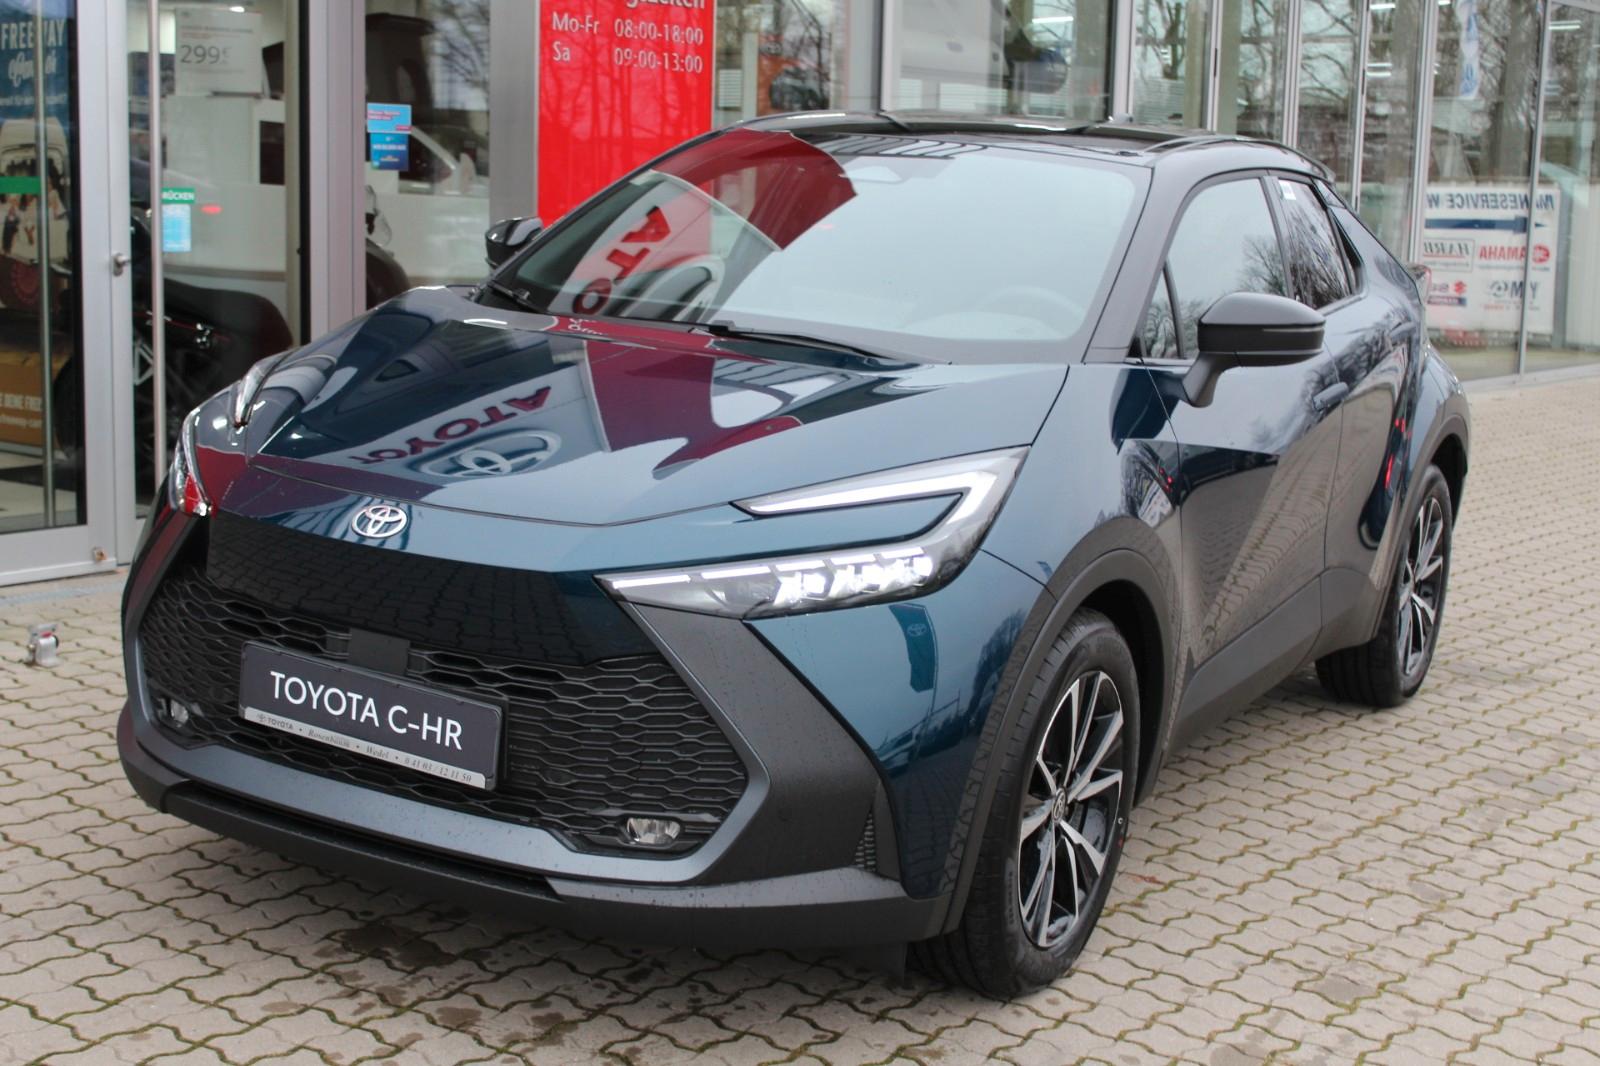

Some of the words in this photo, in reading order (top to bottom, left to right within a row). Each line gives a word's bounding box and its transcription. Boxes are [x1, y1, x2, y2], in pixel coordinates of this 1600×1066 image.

[1, 20, 65, 50] FREEAY
[552, 12, 599, 34] Mo-Fr
[614, 19, 704, 45] 08:00-18:00
[552, 41, 571, 61] Sa
[614, 48, 703, 73] 09:00-13:00
[268, 717, 293, 729] TOYOTA
[270, 671, 379, 727] TOYOTA
[388, 705, 462, 750] C-HR
